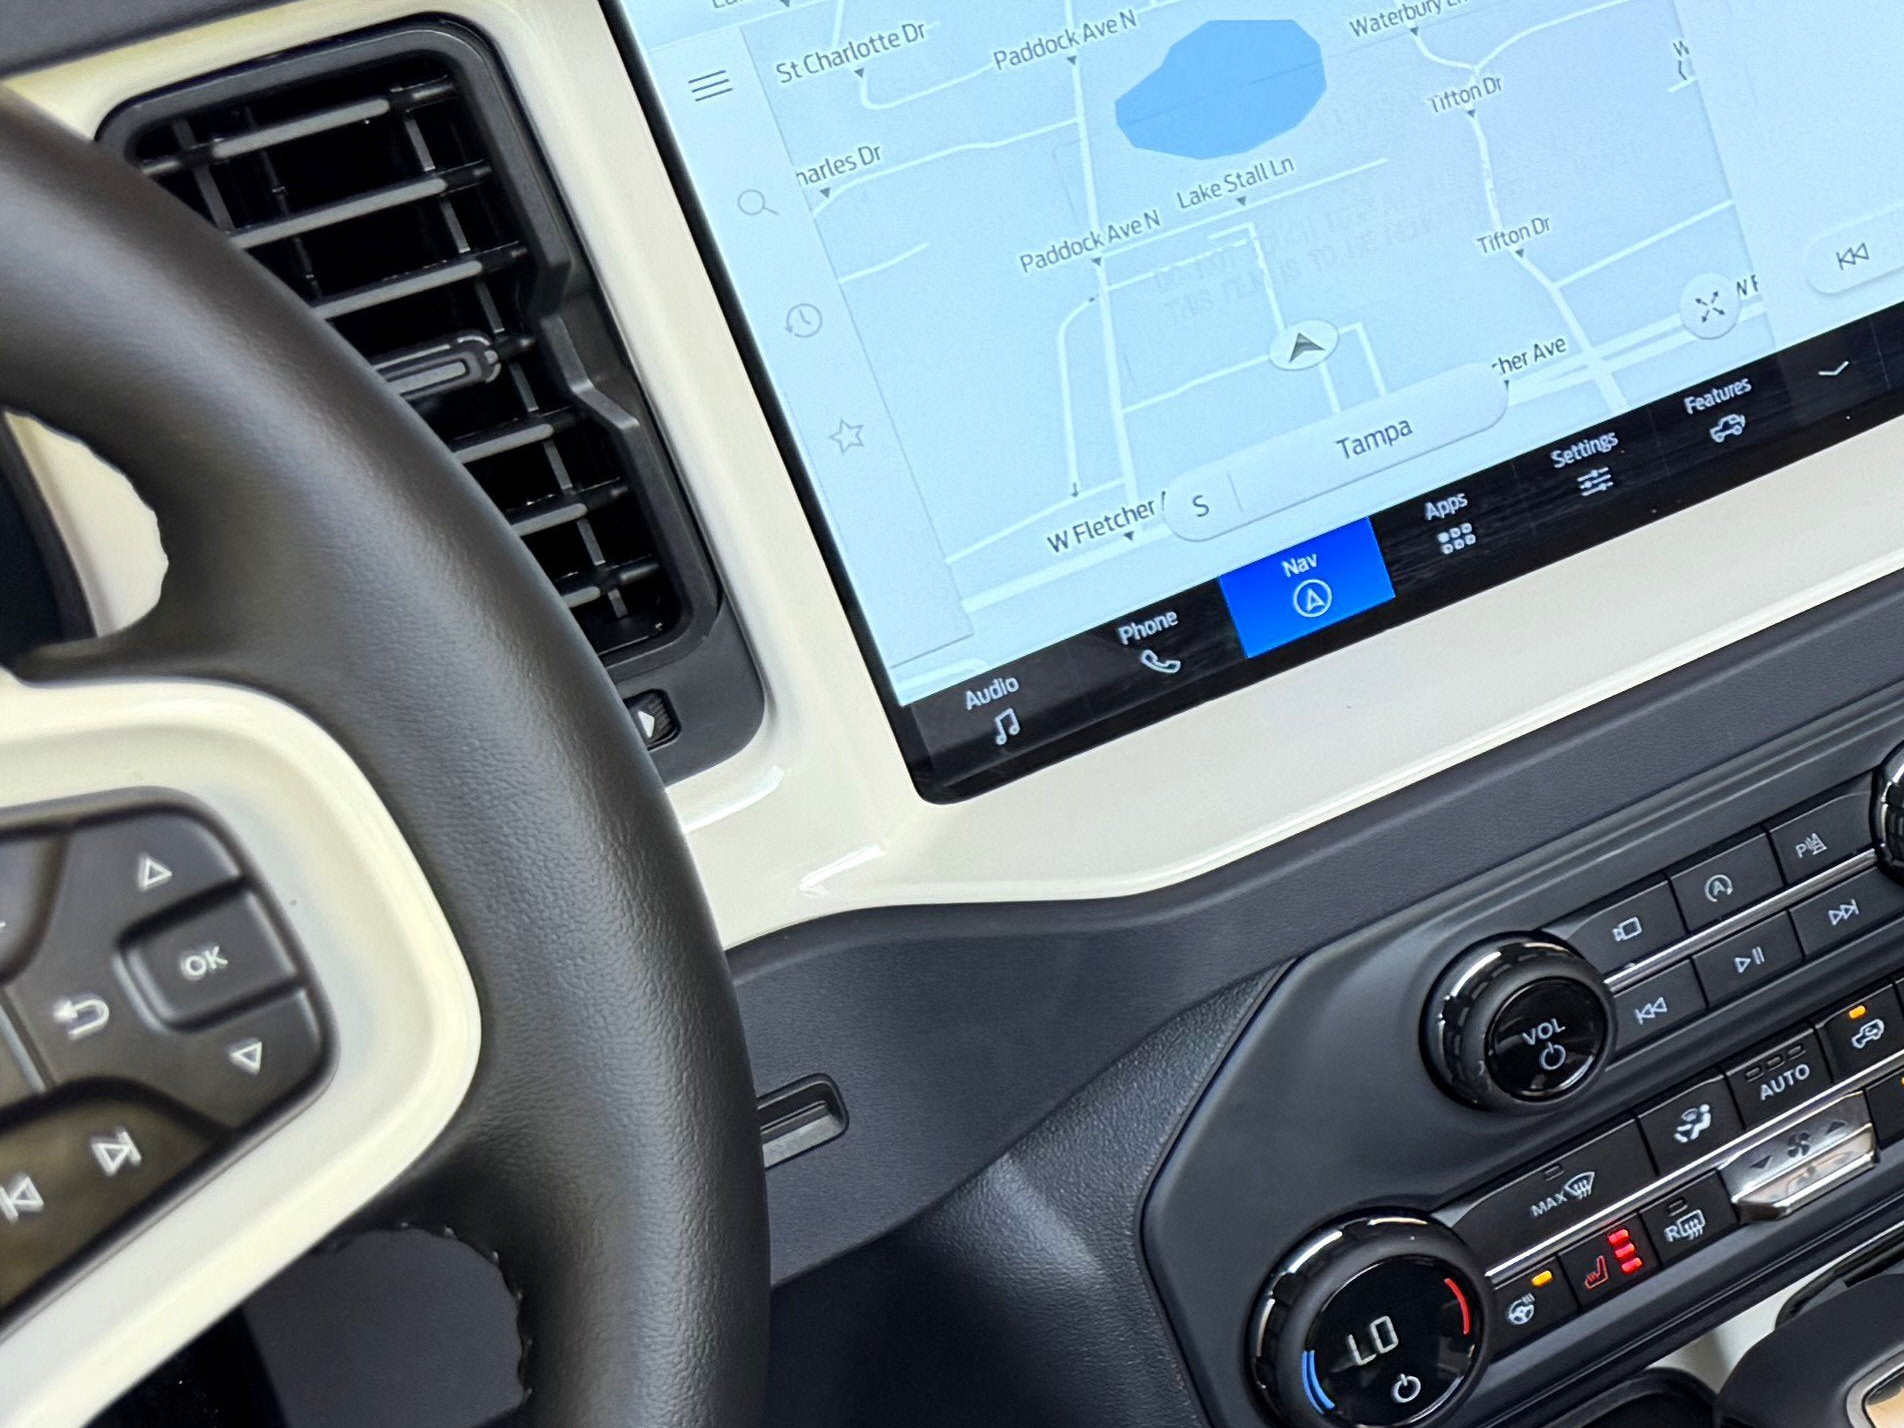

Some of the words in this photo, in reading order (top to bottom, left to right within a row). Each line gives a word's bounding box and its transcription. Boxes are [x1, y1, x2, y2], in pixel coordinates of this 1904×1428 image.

[775, 60, 803, 83] St
[803, 31, 901, 74] Charlotte
[901, 21, 926, 43] Dr
[993, 28, 1080, 70] Paddock
[1080, 18, 1118, 46] Ave
[1119, 9, 1138, 32] N
[1428, 84, 1482, 113] Tifton
[1483, 77, 1503, 95] Dr
[857, 143, 883, 165] Dr
[1177, 180, 1222, 209] Lake
[1223, 162, 1272, 196] Stall
[1273, 155, 1296, 178] Ln
[1020, 231, 1106, 273] Paddock
[1106, 220, 1144, 246] Ave
[1144, 210, 1161, 230] N
[1477, 225, 1531, 253] Tifton
[1531, 217, 1551, 235] Dr
[1534, 337, 1567, 363] Ave
[1684, 377, 1752, 414] Features
[1335, 418, 1414, 460] Tampa
[1550, 431, 1619, 468] Settings
[1191, 494, 1210, 518] S
[1424, 491, 1469, 523] Apps
[1046, 532, 1071, 555] W
[1073, 496, 1157, 546] Fletcher
[1282, 551, 1318, 579] Nav
[1117, 609, 1179, 646] Phone
[964, 675, 1021, 711] Audio
[180, 944, 229, 980] OK
[1522, 1018, 1566, 1047] VOL
[1758, 1062, 1811, 1102] AUTO
[1530, 1190, 1567, 1218] MAX
[1346, 1315, 1400, 1367] LO
